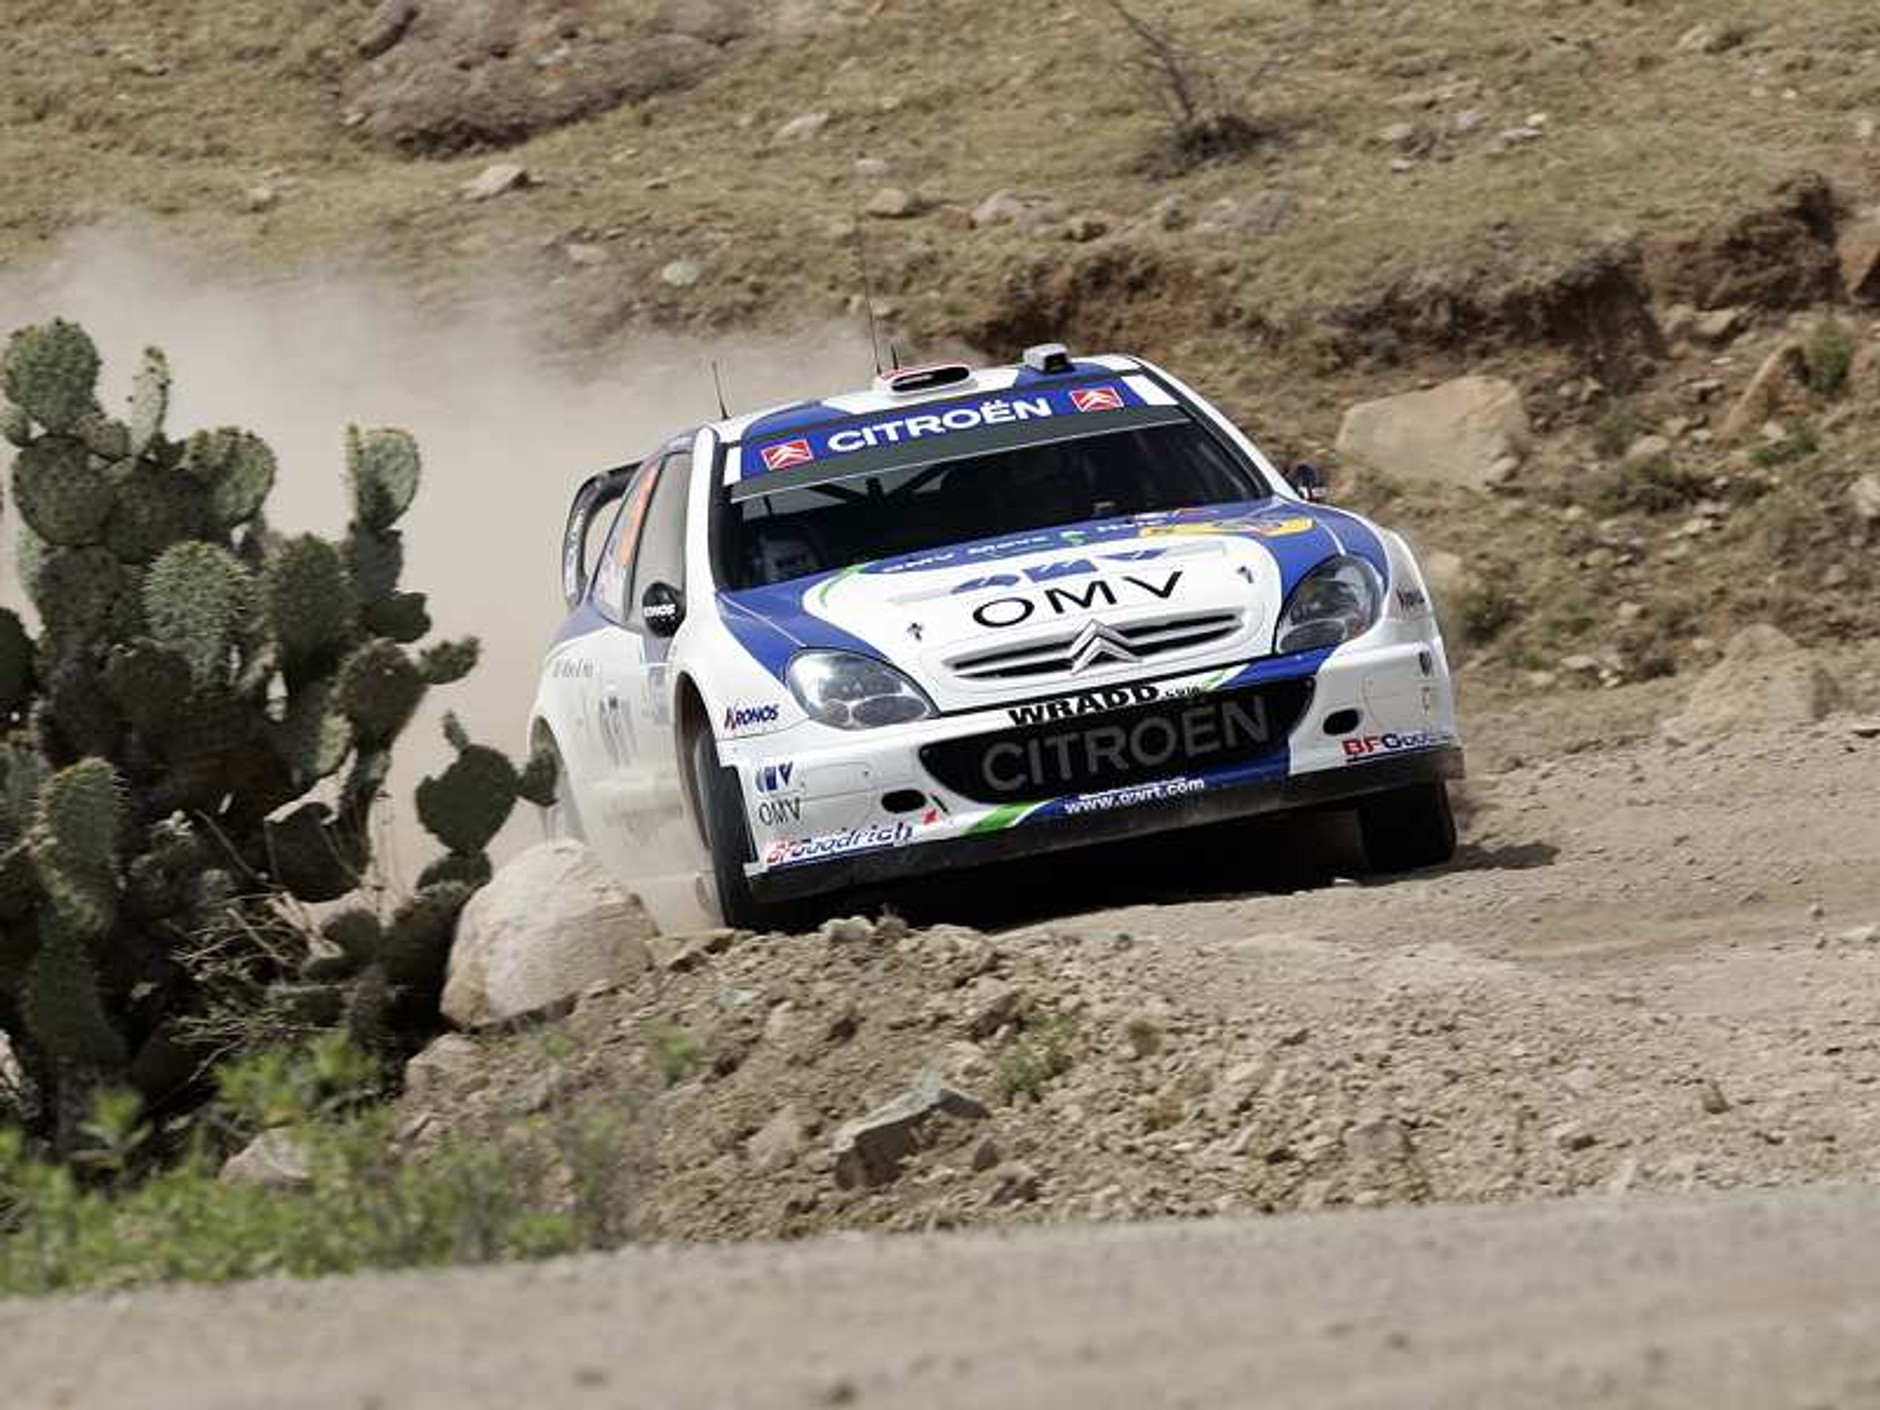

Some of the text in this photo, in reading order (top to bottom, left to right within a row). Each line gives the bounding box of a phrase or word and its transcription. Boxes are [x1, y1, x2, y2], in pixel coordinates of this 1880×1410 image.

[828, 398, 1052, 452] CITROËN
[971, 570, 1183, 629] OMV
[723, 703, 780, 731] KRONOS
[981, 695, 1271, 792] CITROËN
[758, 796, 801, 827] OMV
[766, 822, 913, 864] BFGoodrich
